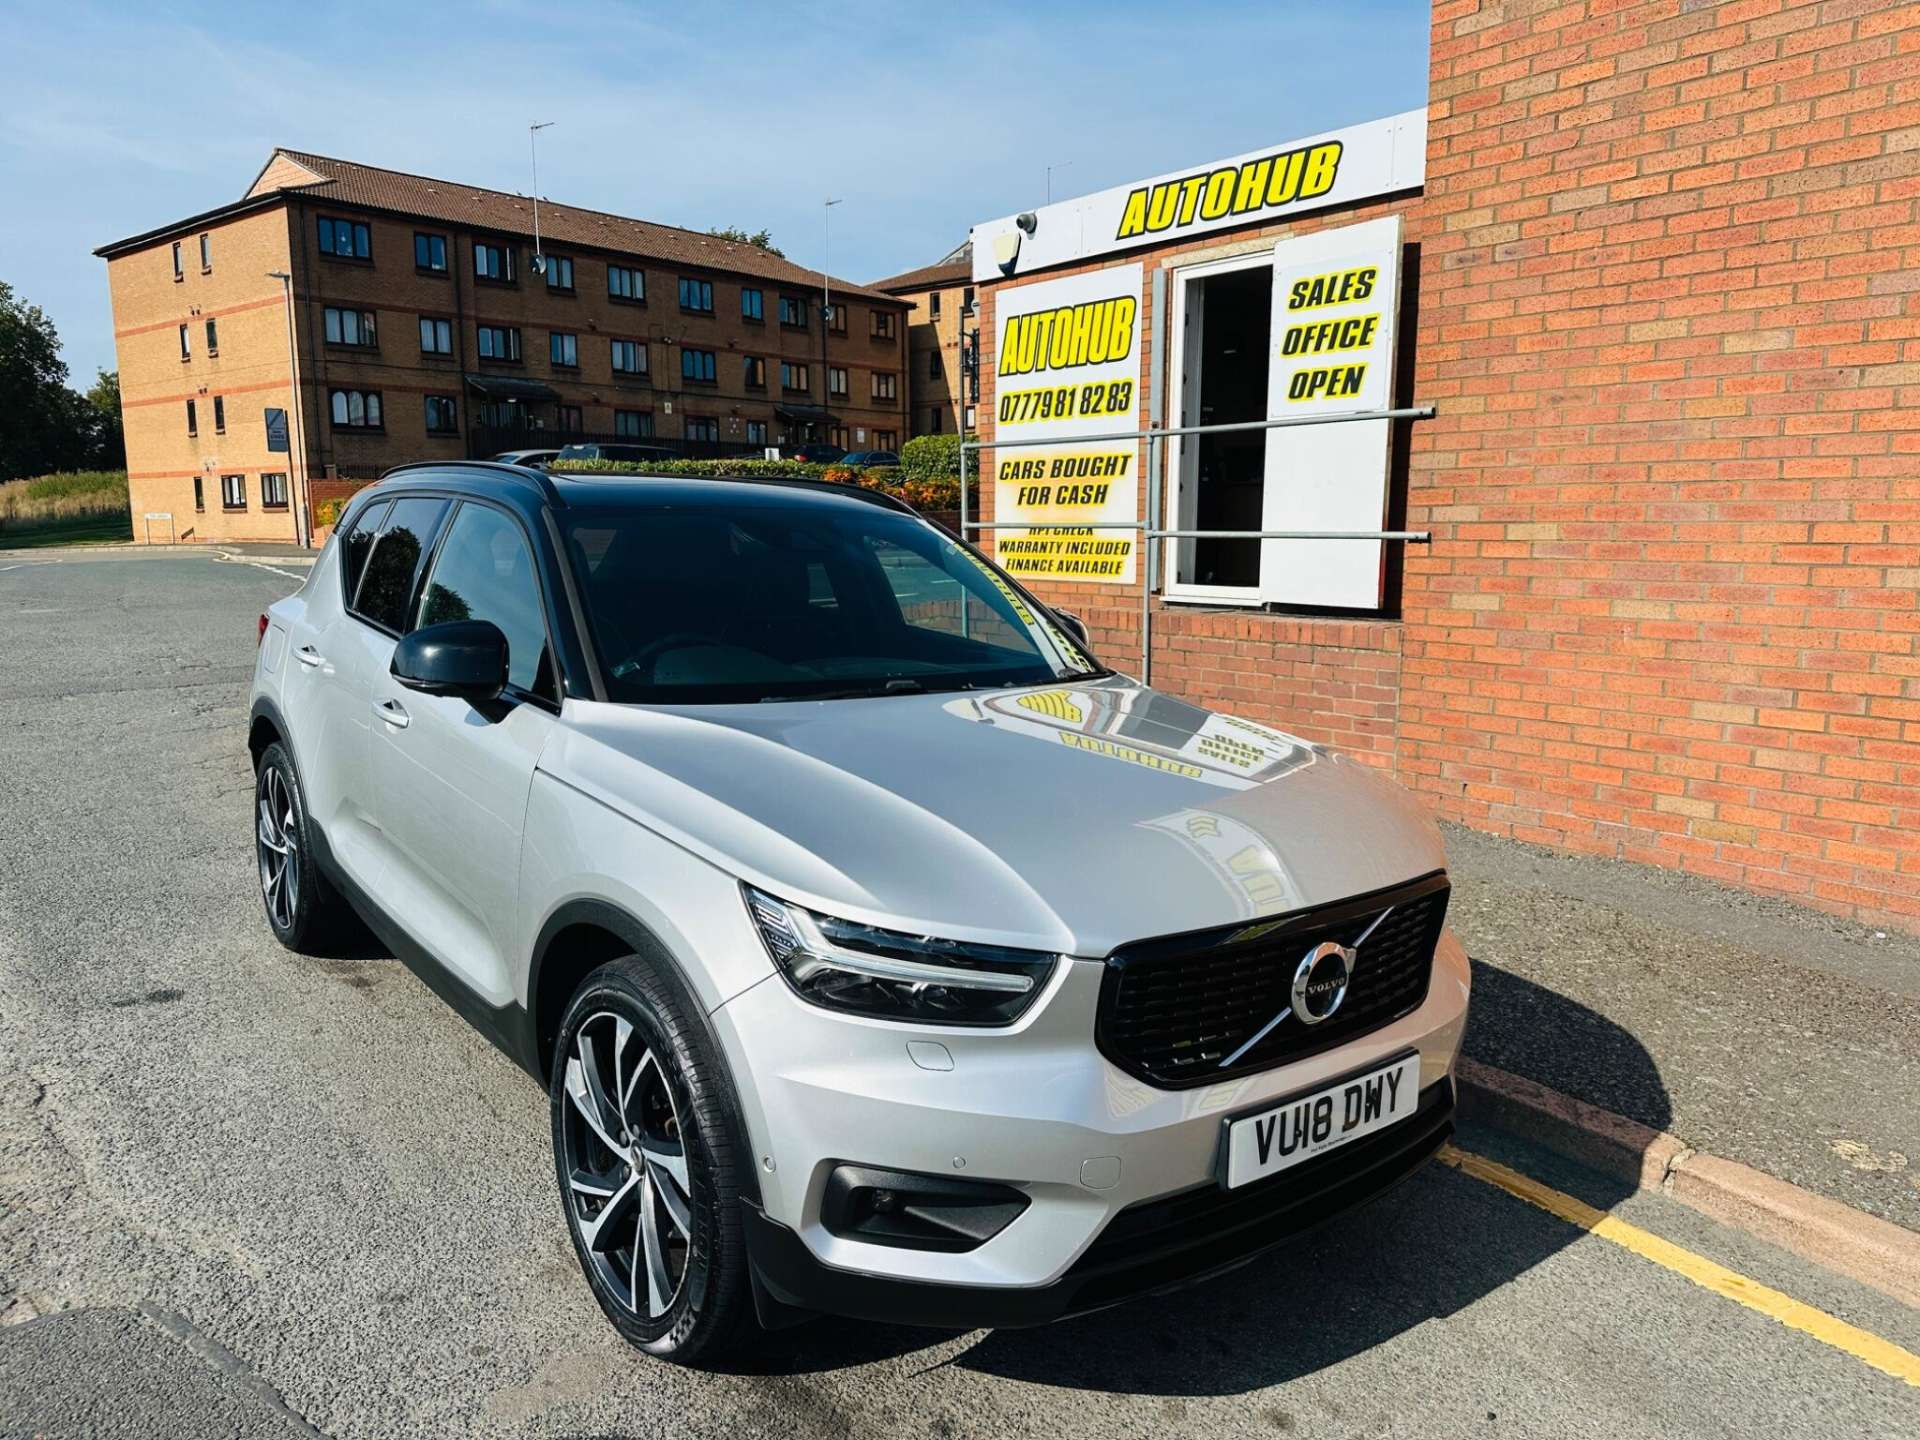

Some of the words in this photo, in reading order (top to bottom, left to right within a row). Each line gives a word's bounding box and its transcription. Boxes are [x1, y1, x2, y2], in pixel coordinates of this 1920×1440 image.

[1115, 140, 1343, 240] AUTOHUB
[1289, 269, 1376, 309] SALES
[998, 295, 1136, 377] AUTOHUB
[1282, 317, 1378, 356] OFFICE
[1289, 366, 1366, 400] OPEN
[1000, 460, 1046, 480] CARS
[1050, 455, 1132, 478] BOUGHT
[1017, 486, 1051, 506] FOR
[1056, 484, 1109, 505] CASH
[999, 541, 1063, 555] WARRANTY
[1065, 541, 1131, 556] INCLUDED
[1005, 558, 1054, 572] FINANCE
[1056, 559, 1122, 575] AVAILABLE
[1308, 977, 1345, 995] VOLVO
[1256, 1095, 1333, 1165] VU18
[1342, 1067, 1404, 1133] DWY
